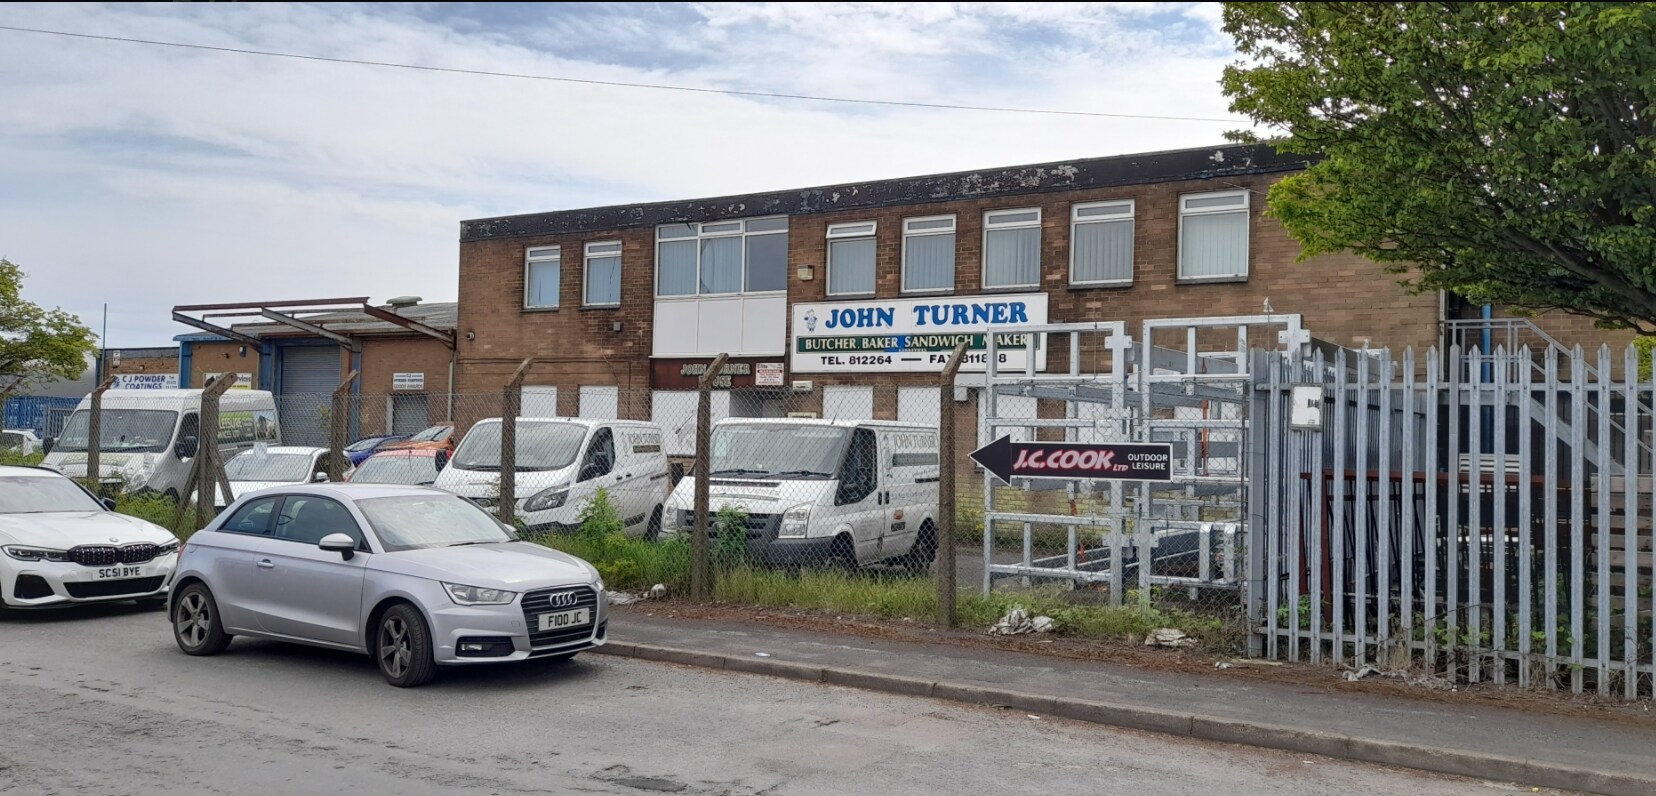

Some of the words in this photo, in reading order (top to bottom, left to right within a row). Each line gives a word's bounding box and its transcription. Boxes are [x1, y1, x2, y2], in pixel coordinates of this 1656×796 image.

[825, 307, 895, 328] JOHN
[913, 302, 1029, 325] TURNER
[904, 334, 974, 348] SANDWICH
[821, 356, 845, 365] TEL.
[849, 355, 892, 365] 812264
[962, 353, 1007, 364] 81188
[681, 363, 707, 375] JOHN
[718, 363, 751, 375] RNER
[122, 375, 127, 383] C
[128, 375, 132, 383] J
[134, 375, 166, 383] POWDER
[1127, 453, 1168, 462] OUTDOOR
[1132, 462, 1166, 470] LEISURE
[99, 568, 121, 578] SC51
[123, 566, 141, 577] BYE
[548, 613, 569, 627] F100
[571, 611, 582, 624] JC
